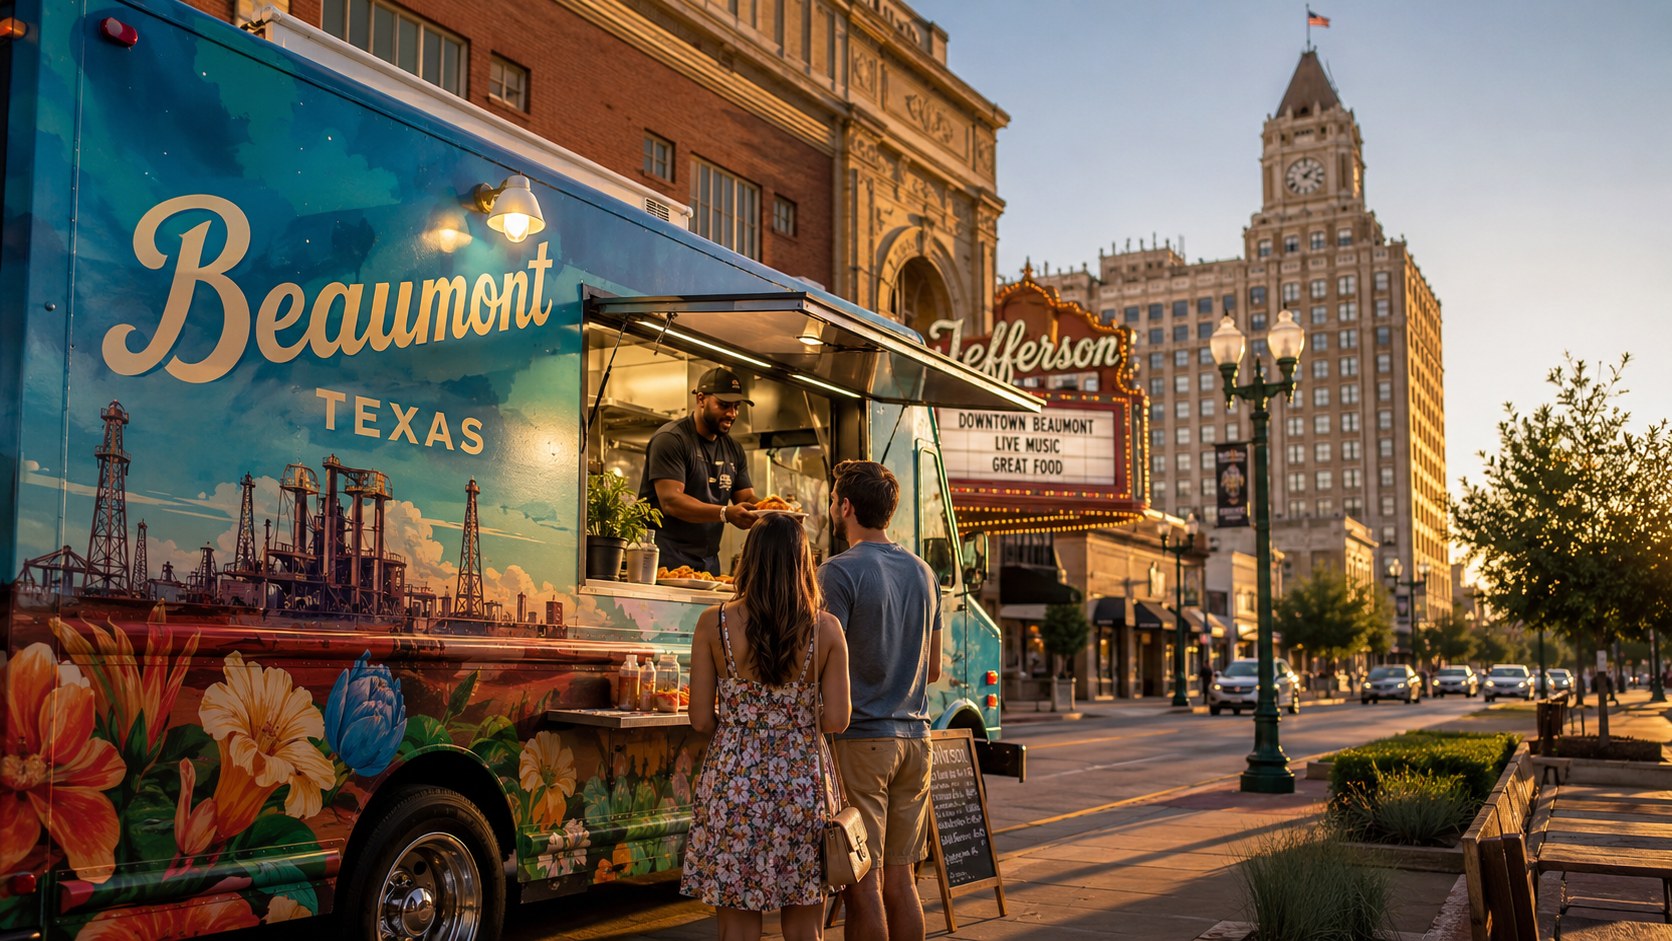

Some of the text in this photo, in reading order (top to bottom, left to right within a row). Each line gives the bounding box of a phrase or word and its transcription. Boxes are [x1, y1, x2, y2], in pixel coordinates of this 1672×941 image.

[102, 194, 553, 384] Beaumont
[929, 317, 1120, 385] Jefferson
[315, 387, 485, 455] TEXAS
[959, 412, 1094, 434] DOWNTOWN BEAUMONT
[993, 457, 1063, 475] GREAT FOOD
[995, 436, 1060, 454] LIVE MUSIC
